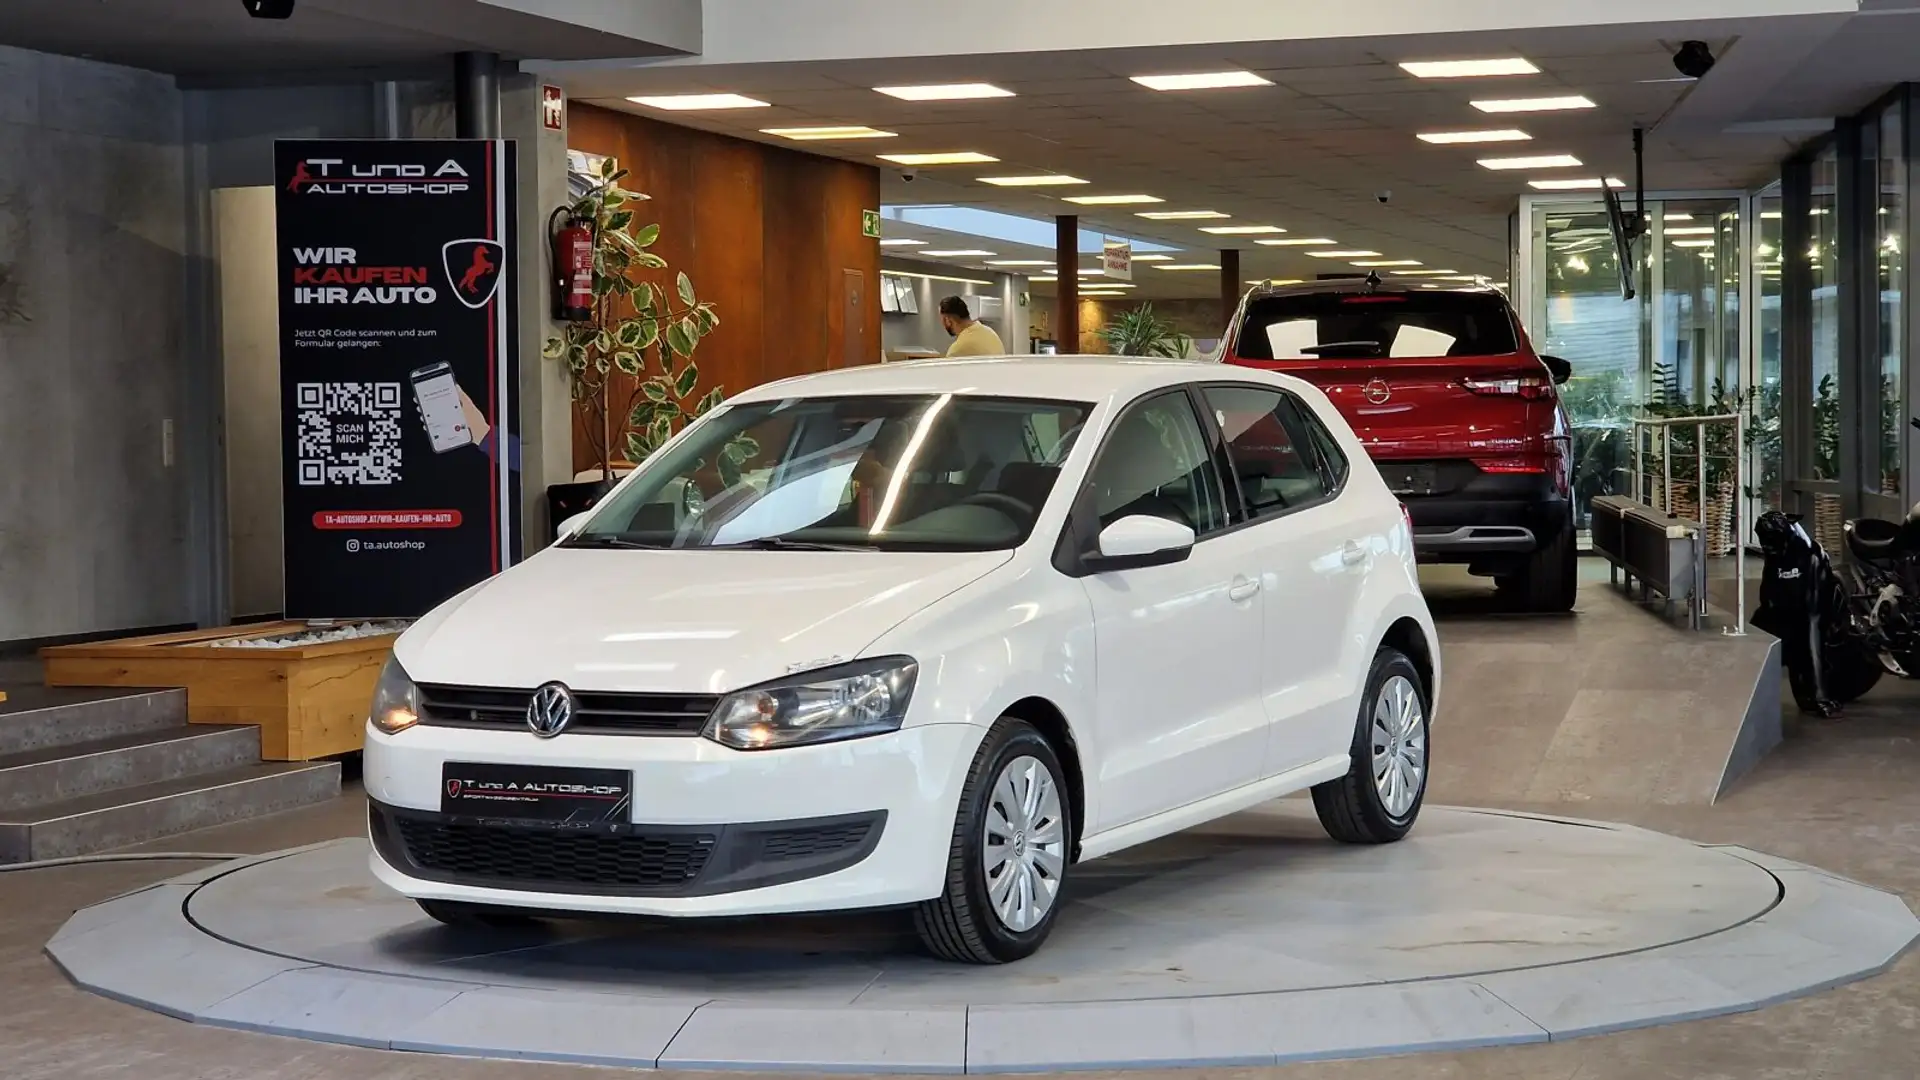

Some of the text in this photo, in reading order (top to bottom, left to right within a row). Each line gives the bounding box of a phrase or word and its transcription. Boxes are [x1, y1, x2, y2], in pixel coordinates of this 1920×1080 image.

[306, 159, 343, 176] T
[433, 159, 469, 177] A
[307, 184, 469, 194] AUTOSHOP
[293, 247, 356, 264] WIR
[294, 267, 427, 284] KAUFEN
[294, 287, 437, 304] IHR AUTO
[295, 329, 437, 338] Jetzt QR Code scannen und zum
[337, 339, 381, 349] gelangen:
[336, 424, 364, 433] SCAN
[336, 434, 364, 443] MICH
[363, 540, 425, 550] ta.autoshop
[463, 780, 475, 788] T
[507, 782, 519, 790] A
[524, 783, 622, 794] AUTOSHOP
